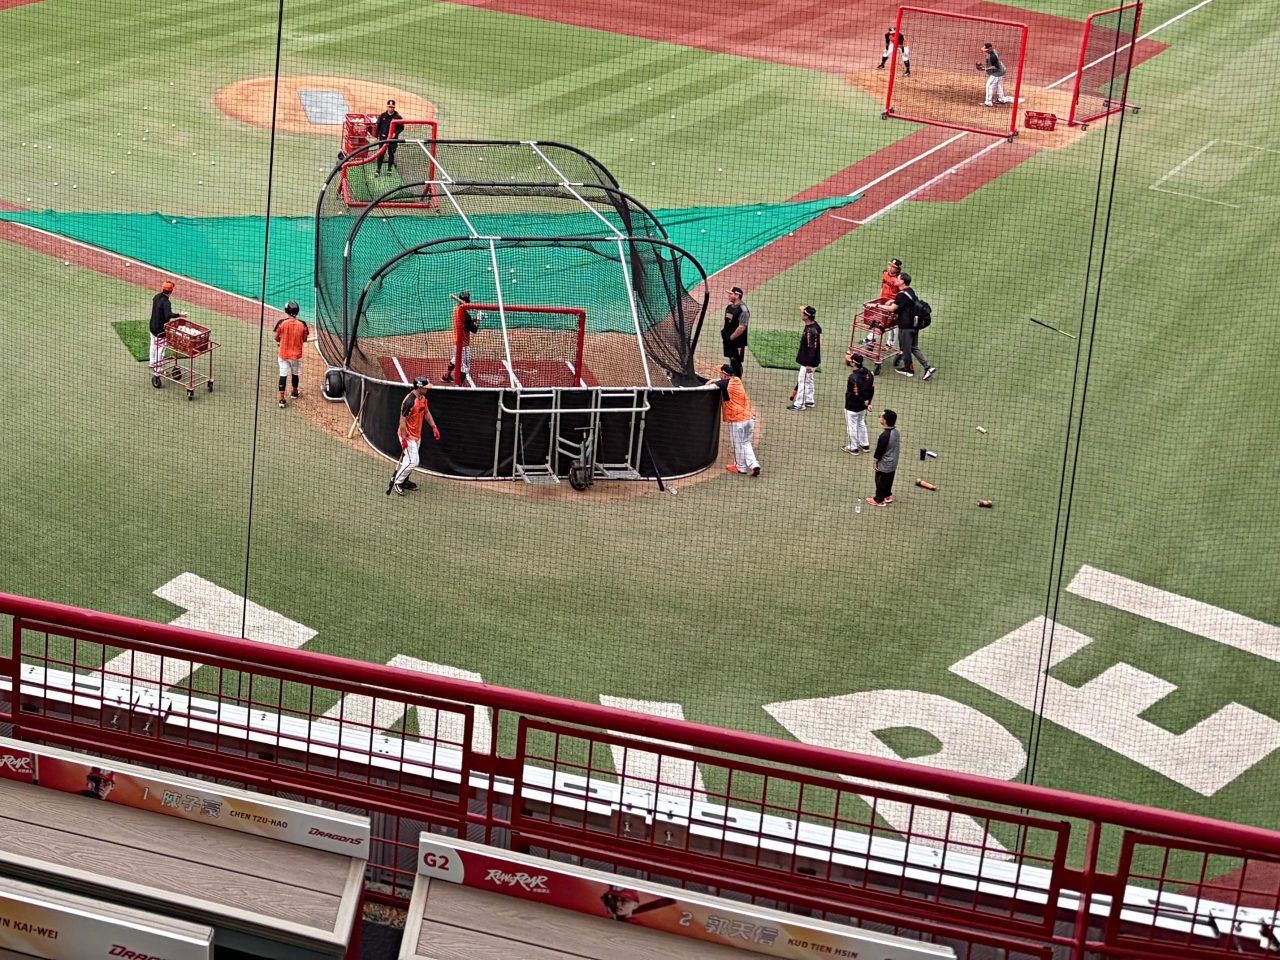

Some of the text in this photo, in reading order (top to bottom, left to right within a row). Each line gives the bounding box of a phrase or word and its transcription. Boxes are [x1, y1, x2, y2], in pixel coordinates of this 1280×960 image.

[161, 790, 223, 819] 陳子豪
[230, 810, 288, 829] CHEN TZU-HAO
[423, 852, 450, 871] G2
[679, 911, 694, 927] 2
[13, 920, 58, 939] KAI-WEI
[705, 915, 779, 947] 郭天信
[788, 937, 858, 960] KUO TIEN HSIN
